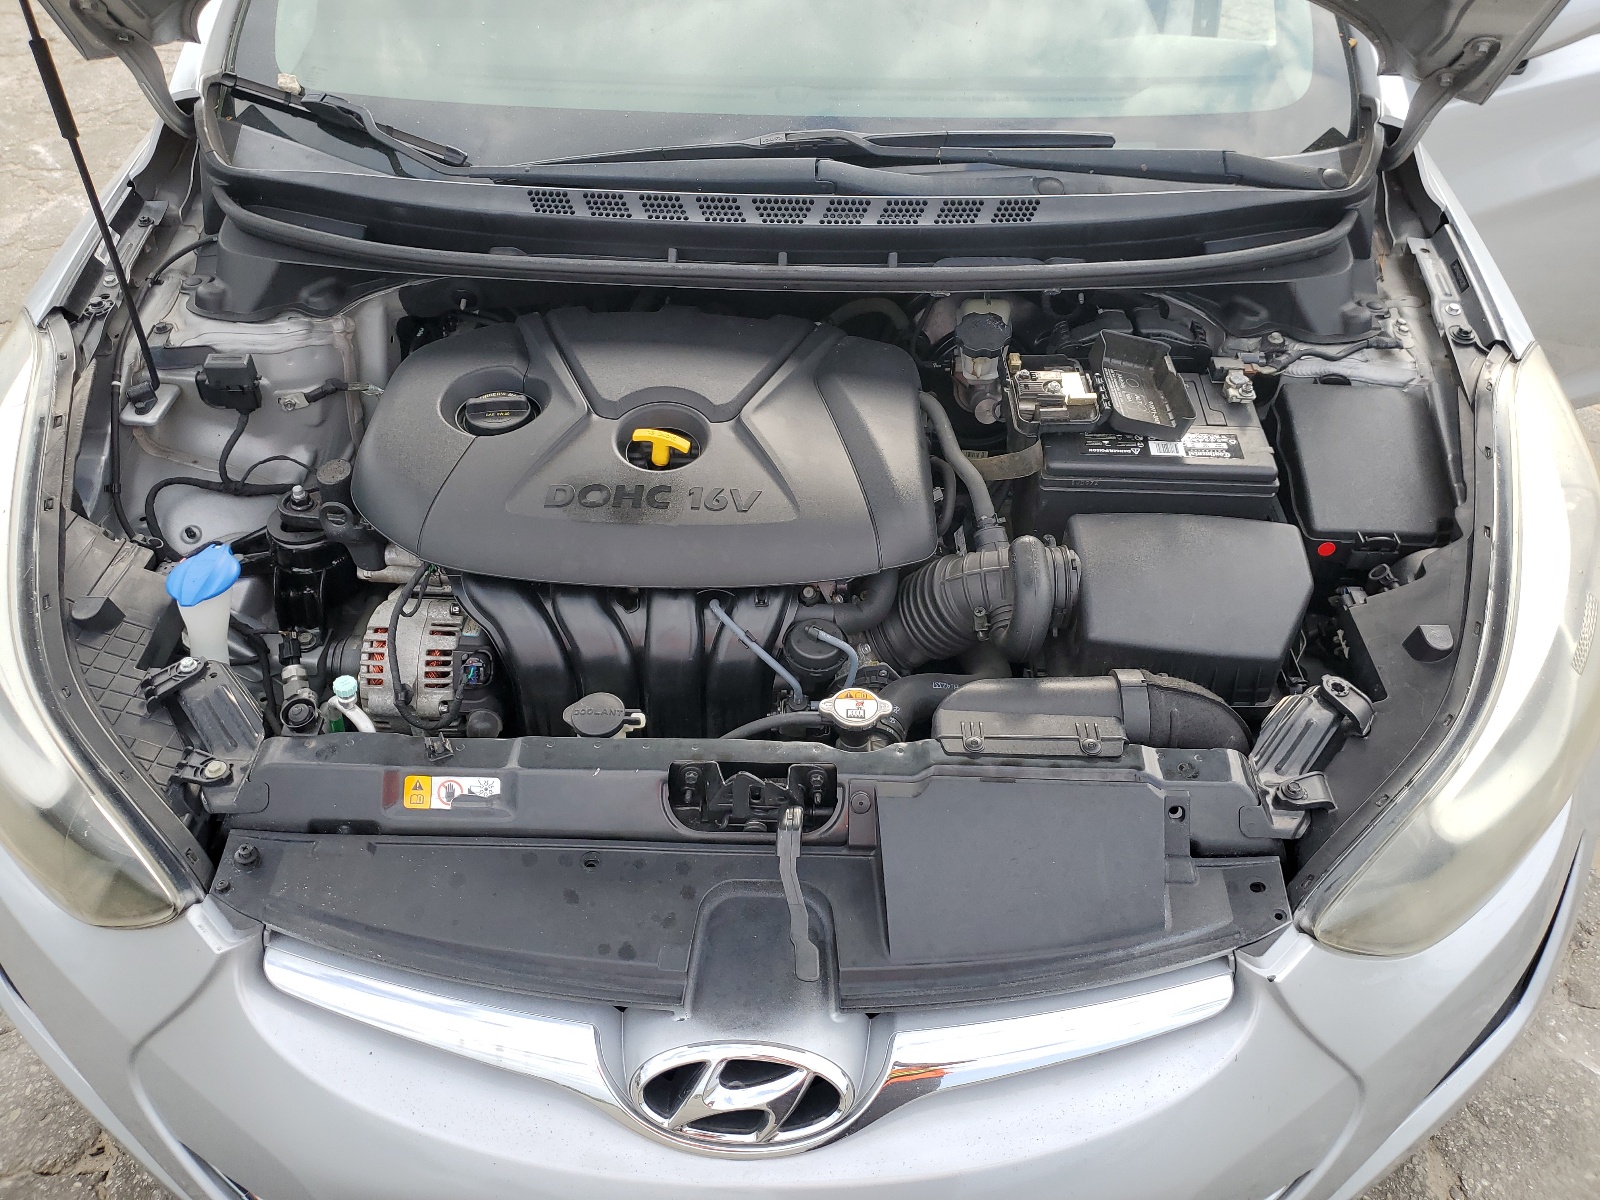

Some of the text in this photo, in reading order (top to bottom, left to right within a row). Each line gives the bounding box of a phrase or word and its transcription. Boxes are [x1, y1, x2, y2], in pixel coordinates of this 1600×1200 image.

[544, 483, 762, 513] DOHC 16V
[573, 707, 623, 717] COOLANT
